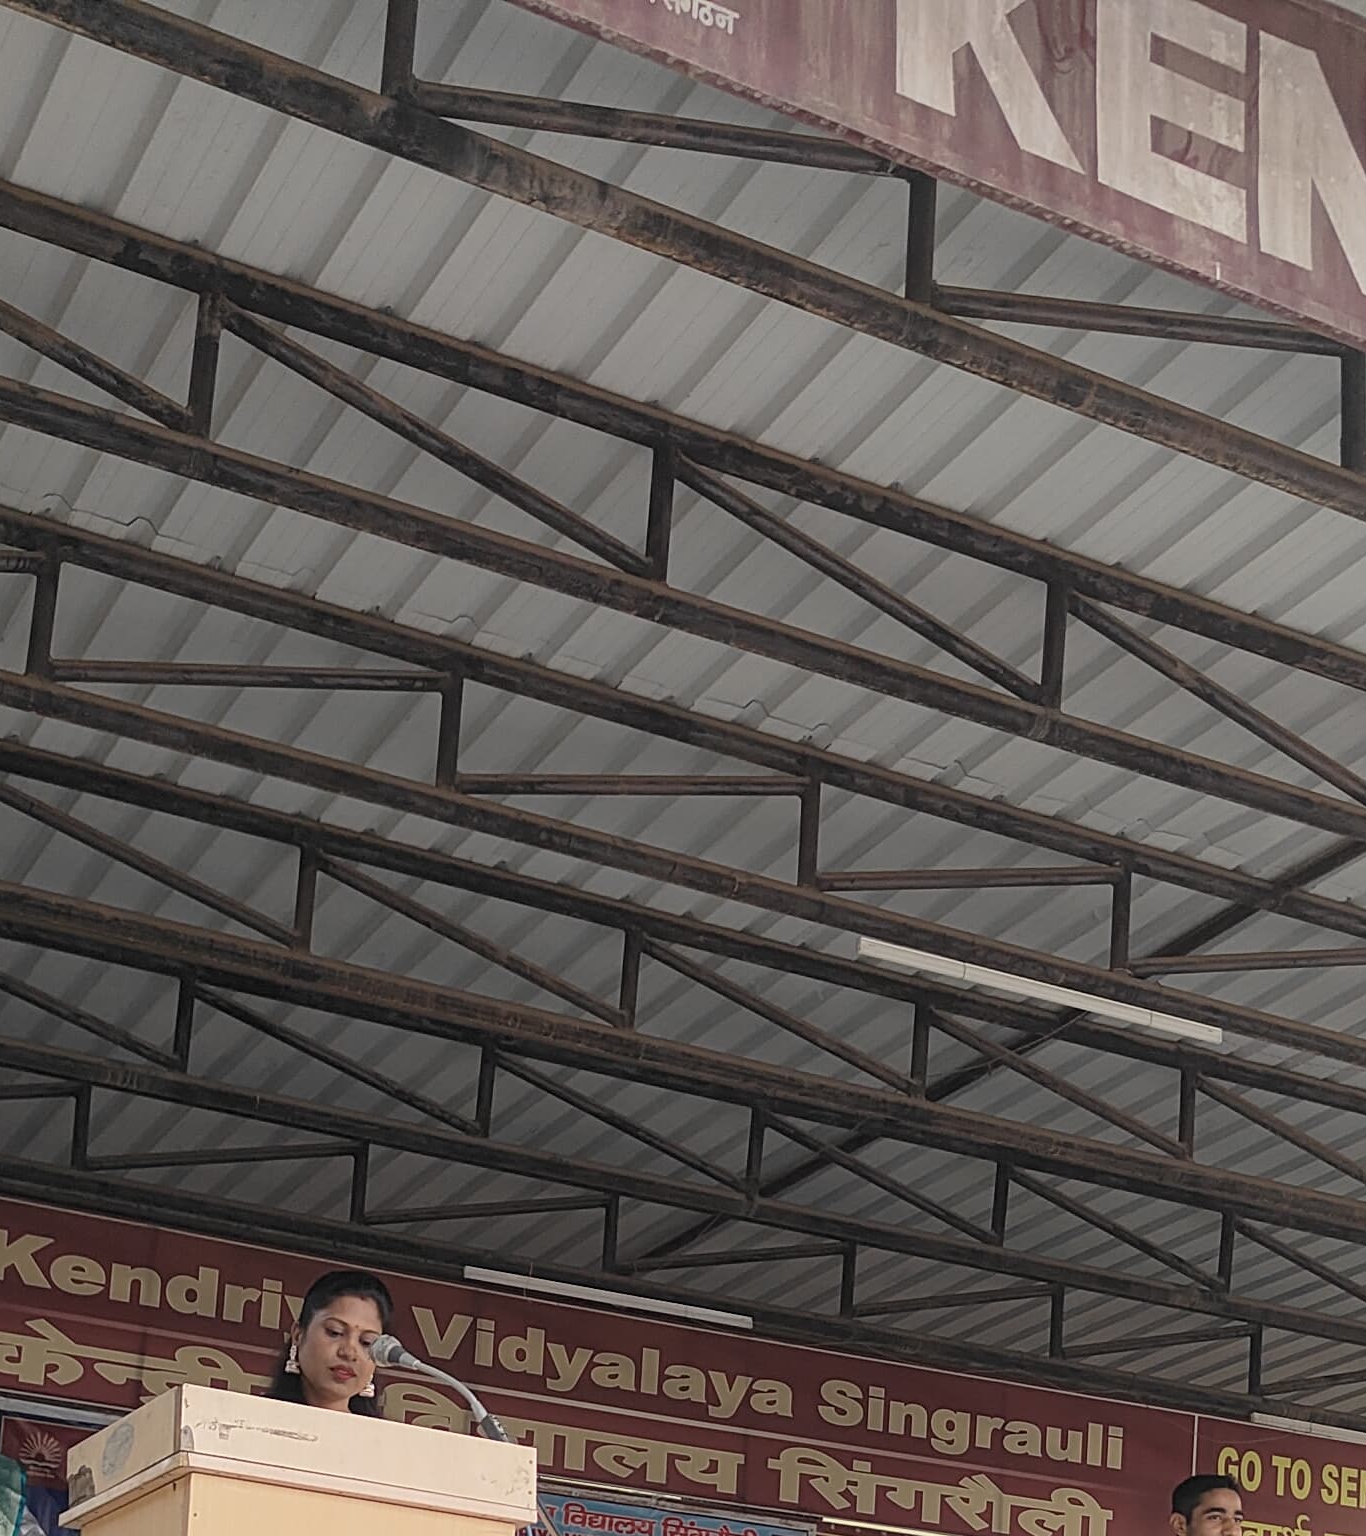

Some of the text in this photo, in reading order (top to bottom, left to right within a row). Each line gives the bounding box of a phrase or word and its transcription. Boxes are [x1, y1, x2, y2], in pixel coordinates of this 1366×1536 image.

[411, 1306, 793, 1420] Vidyalaya
[818, 1377, 1124, 1471] Singrauli
[1217, 1446, 1262, 1492] GO
[1271, 1455, 1312, 1500] TO
[563, 1502, 656, 1536] विद्यालय
